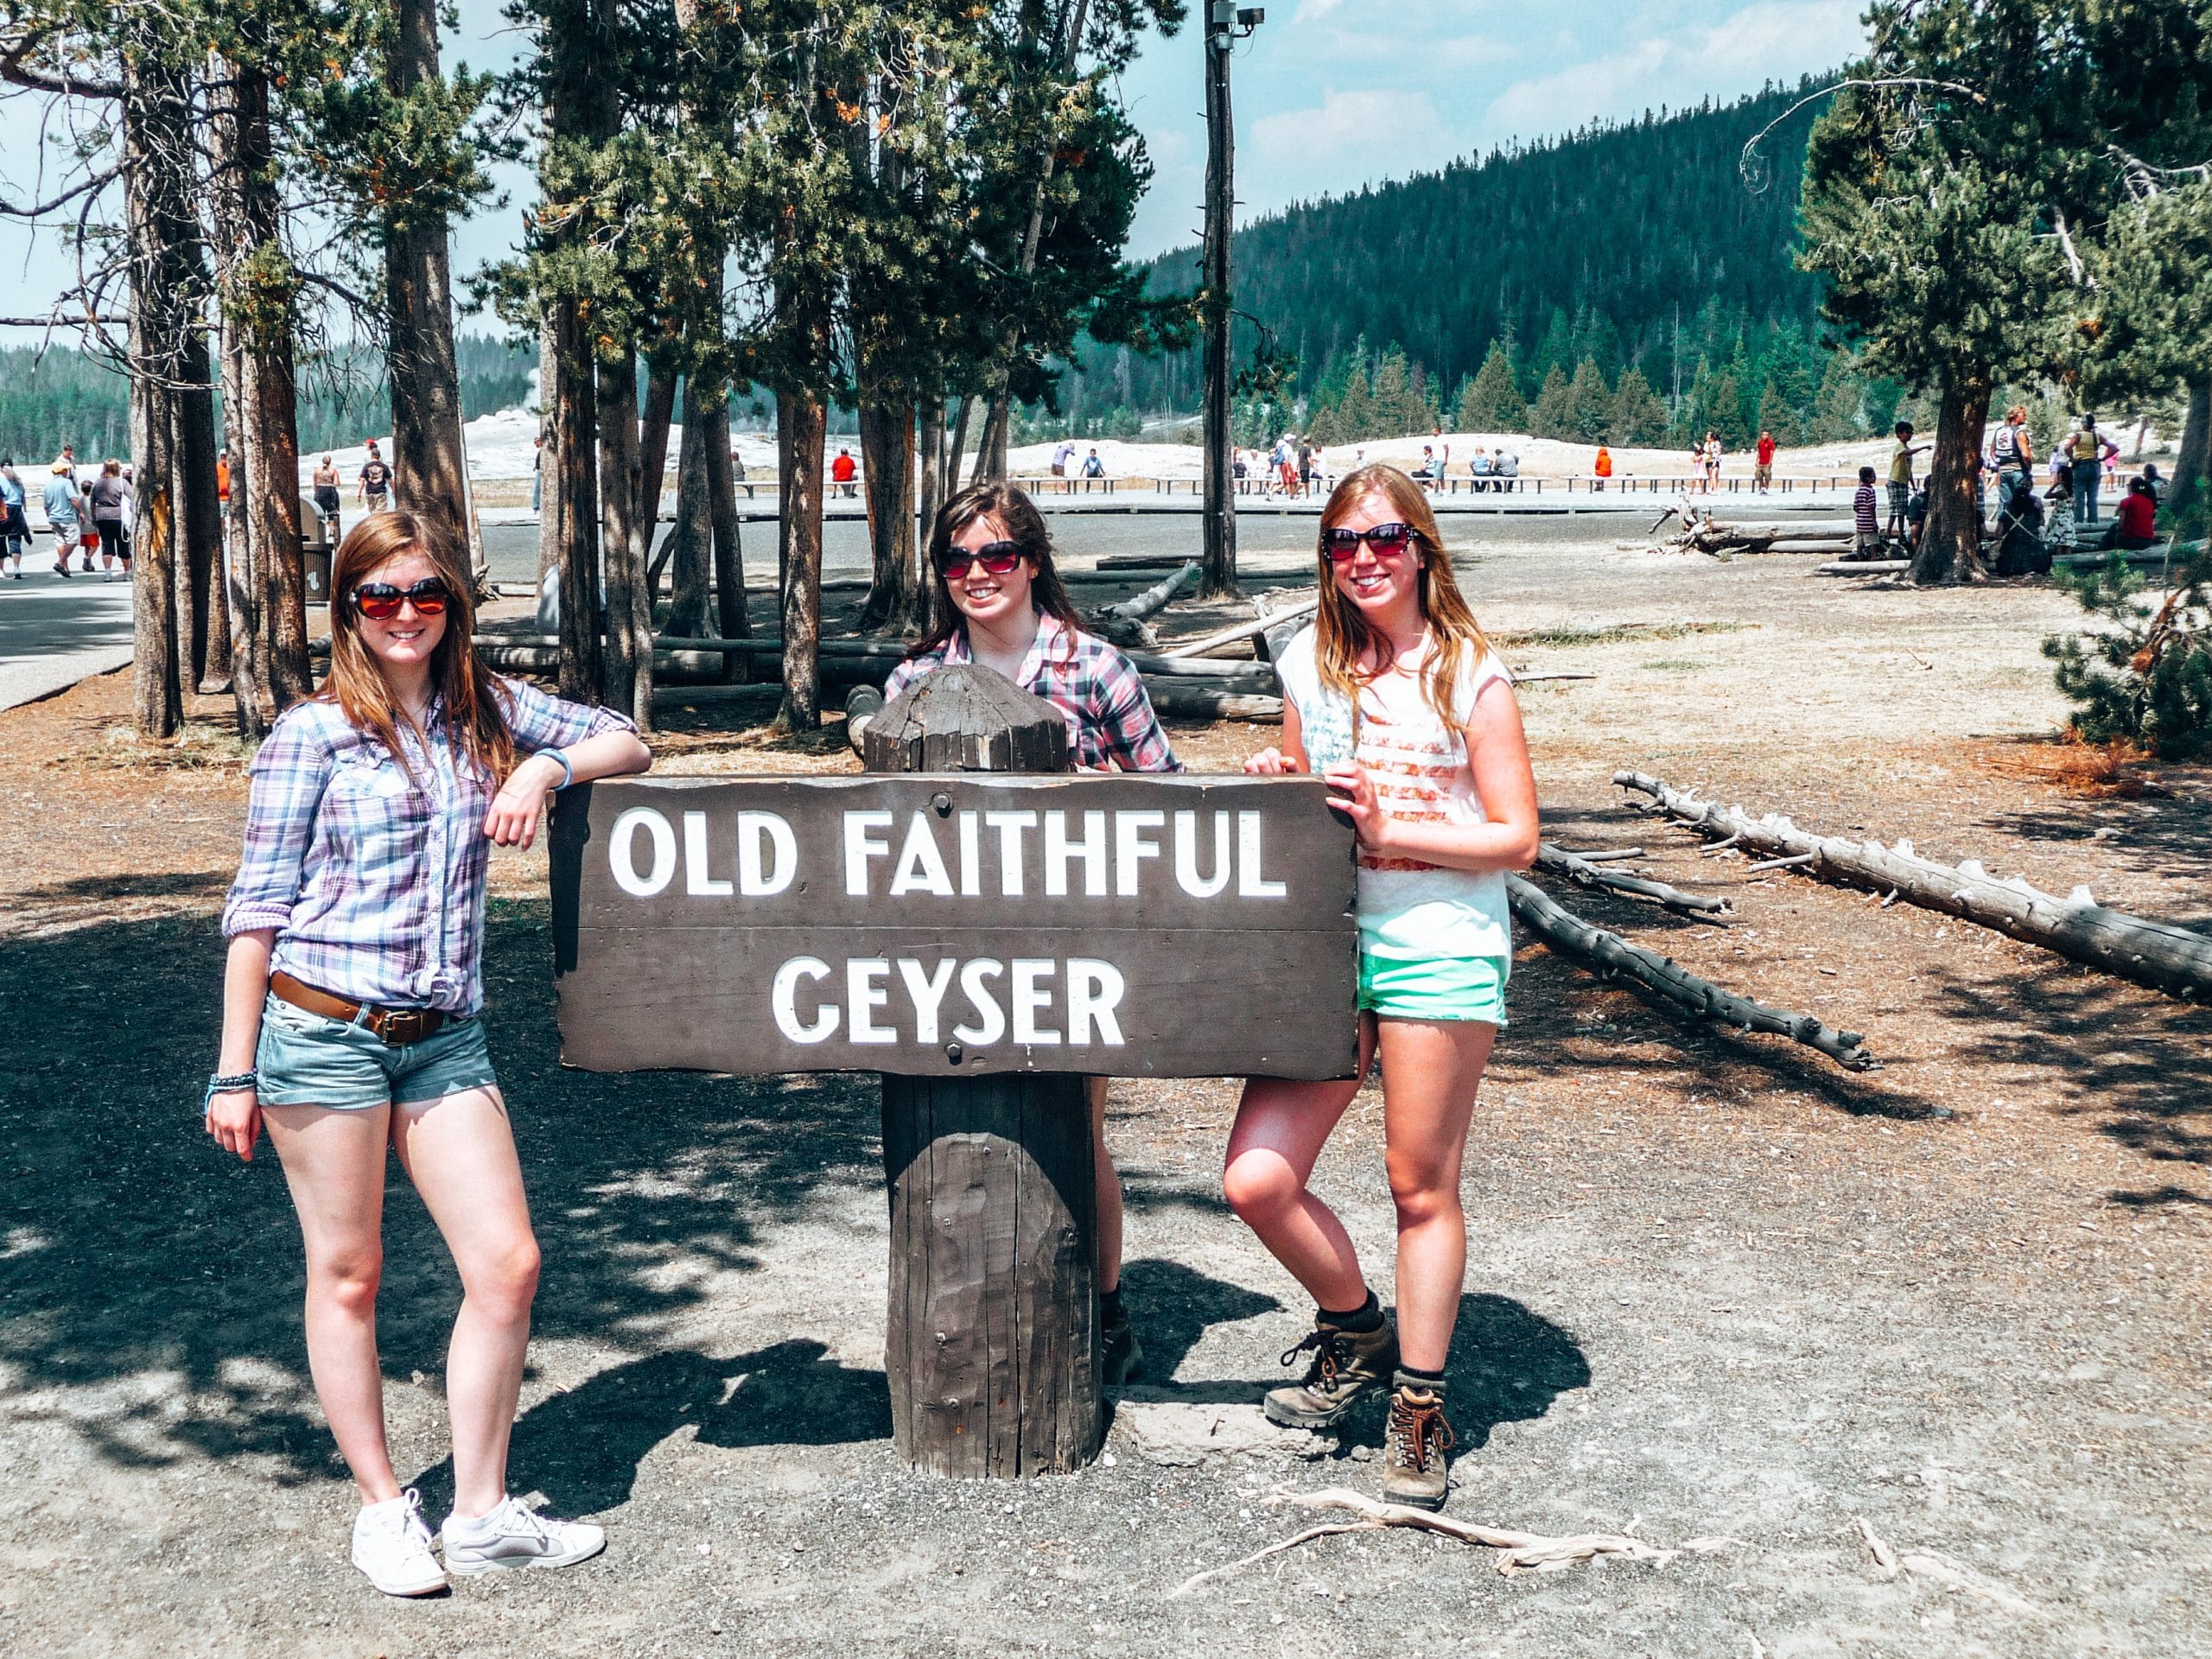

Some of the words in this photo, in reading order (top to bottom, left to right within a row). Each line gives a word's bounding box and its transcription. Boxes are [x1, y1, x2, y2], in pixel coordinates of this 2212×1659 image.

[608, 806, 798, 898] OLD
[843, 809, 1287, 899] FAITHFUL
[772, 956, 1126, 1046] GEYSER
